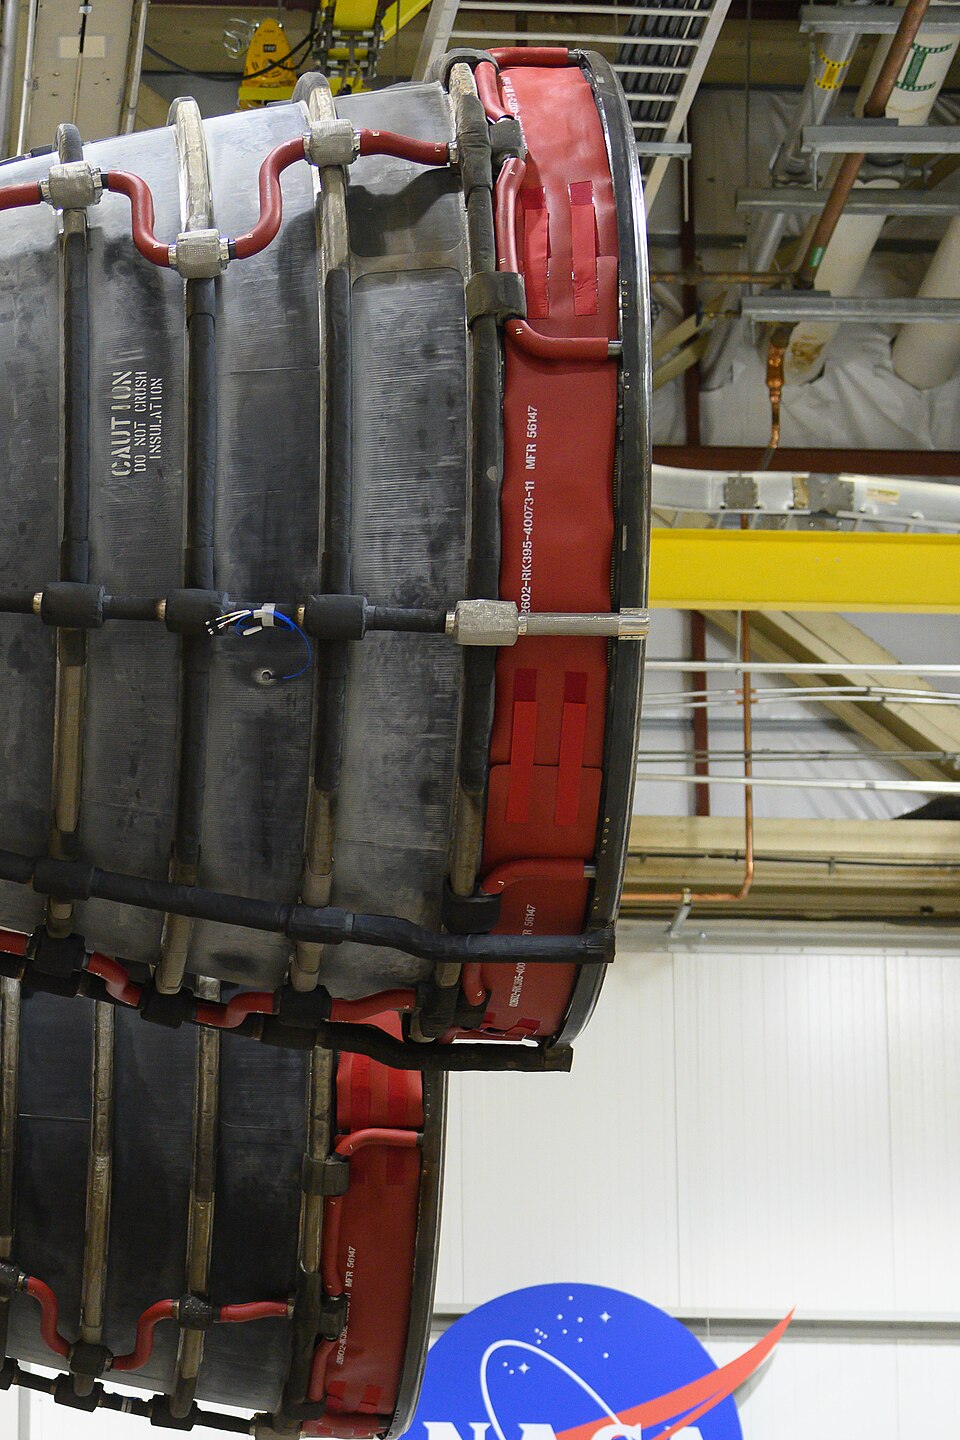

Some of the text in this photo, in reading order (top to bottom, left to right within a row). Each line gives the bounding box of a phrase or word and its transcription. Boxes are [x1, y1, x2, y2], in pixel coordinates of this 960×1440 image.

[111, 371, 132, 476] CAUTION
[133, 371, 147, 472] DO NOT CRUSH
[149, 378, 162, 459] INSULATION
[525, 405, 538, 439] 56147
[525, 443, 537, 470] MFR
[524, 903, 536, 927] 56147
[346, 1245, 356, 1269] 56147
[344, 1270, 354, 1288] MFR
